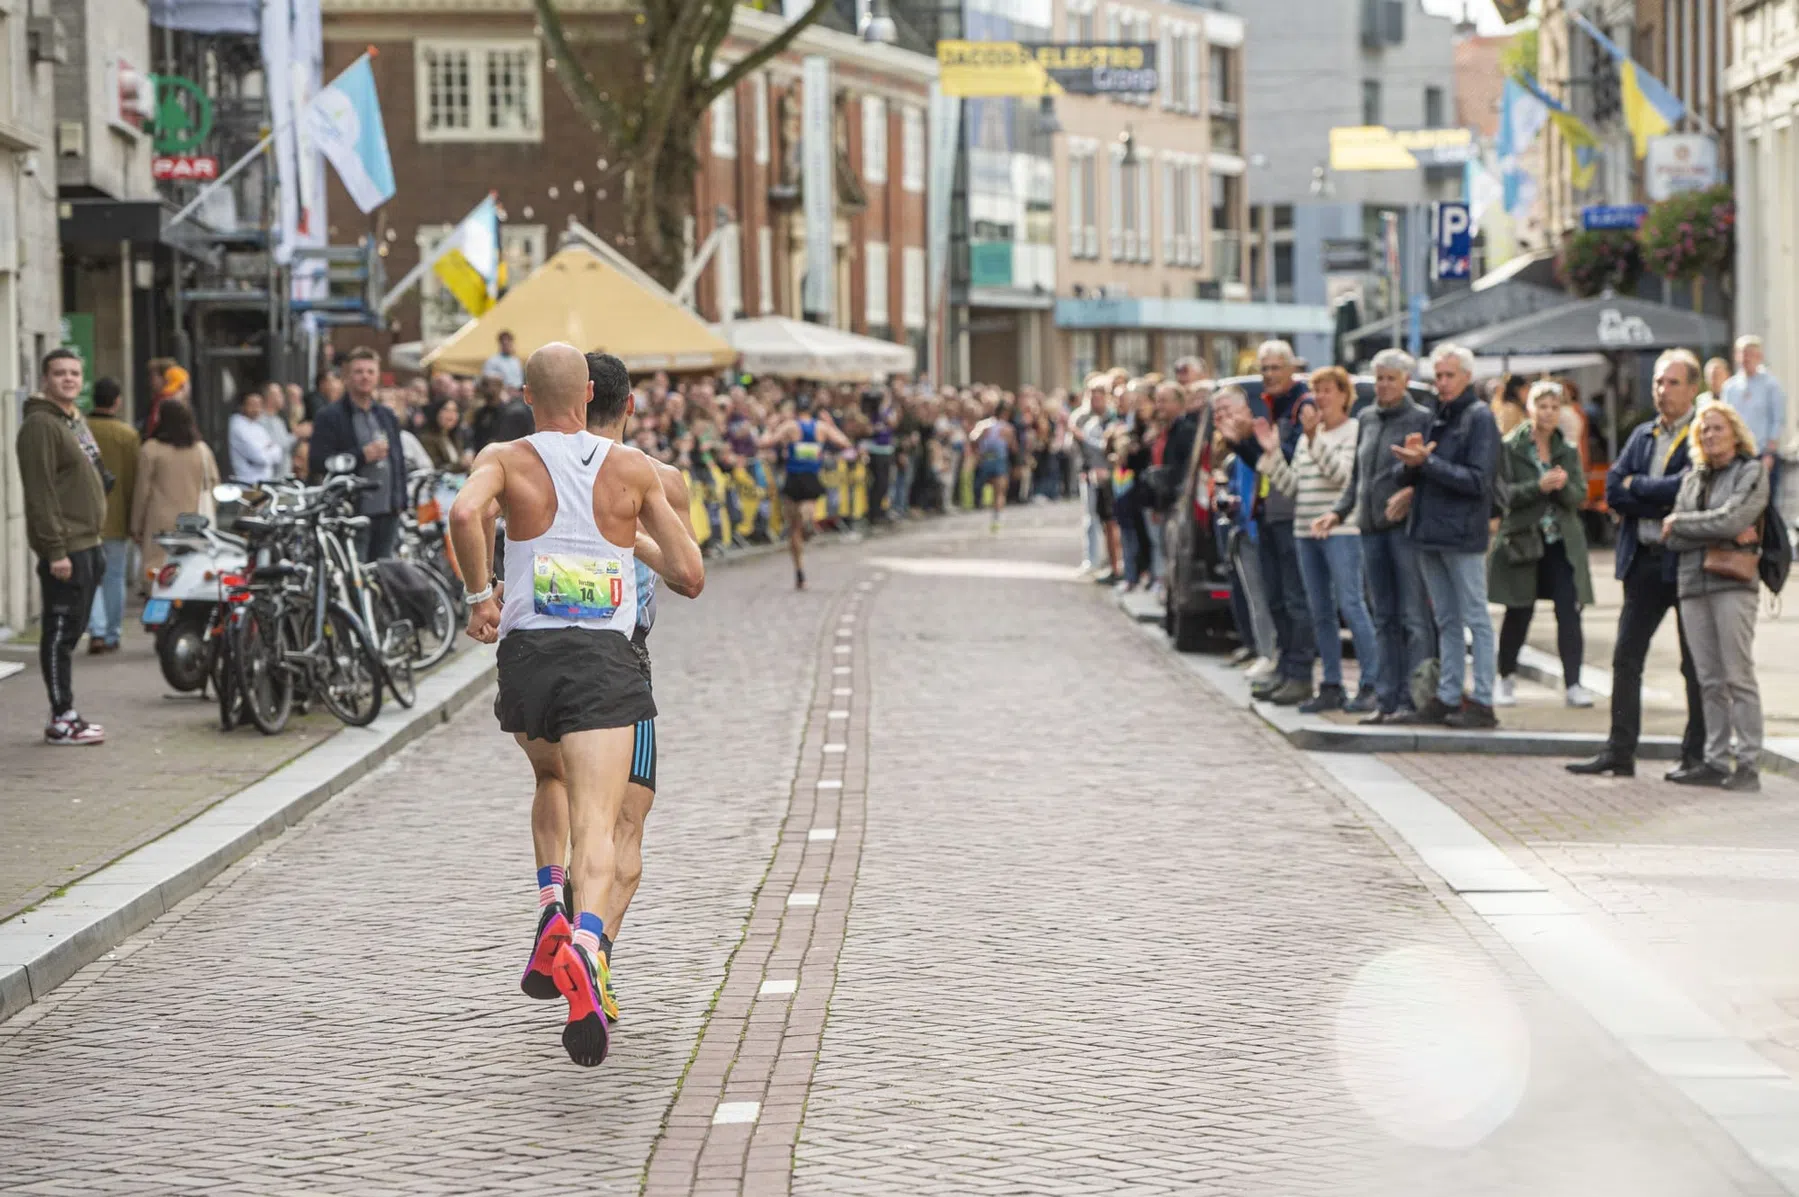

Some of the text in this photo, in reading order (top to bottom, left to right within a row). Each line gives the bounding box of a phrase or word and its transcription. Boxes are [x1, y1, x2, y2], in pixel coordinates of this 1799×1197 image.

[153, 158, 214, 177] PAR
[1442, 206, 1469, 247] P
[580, 588, 595, 603] 14
